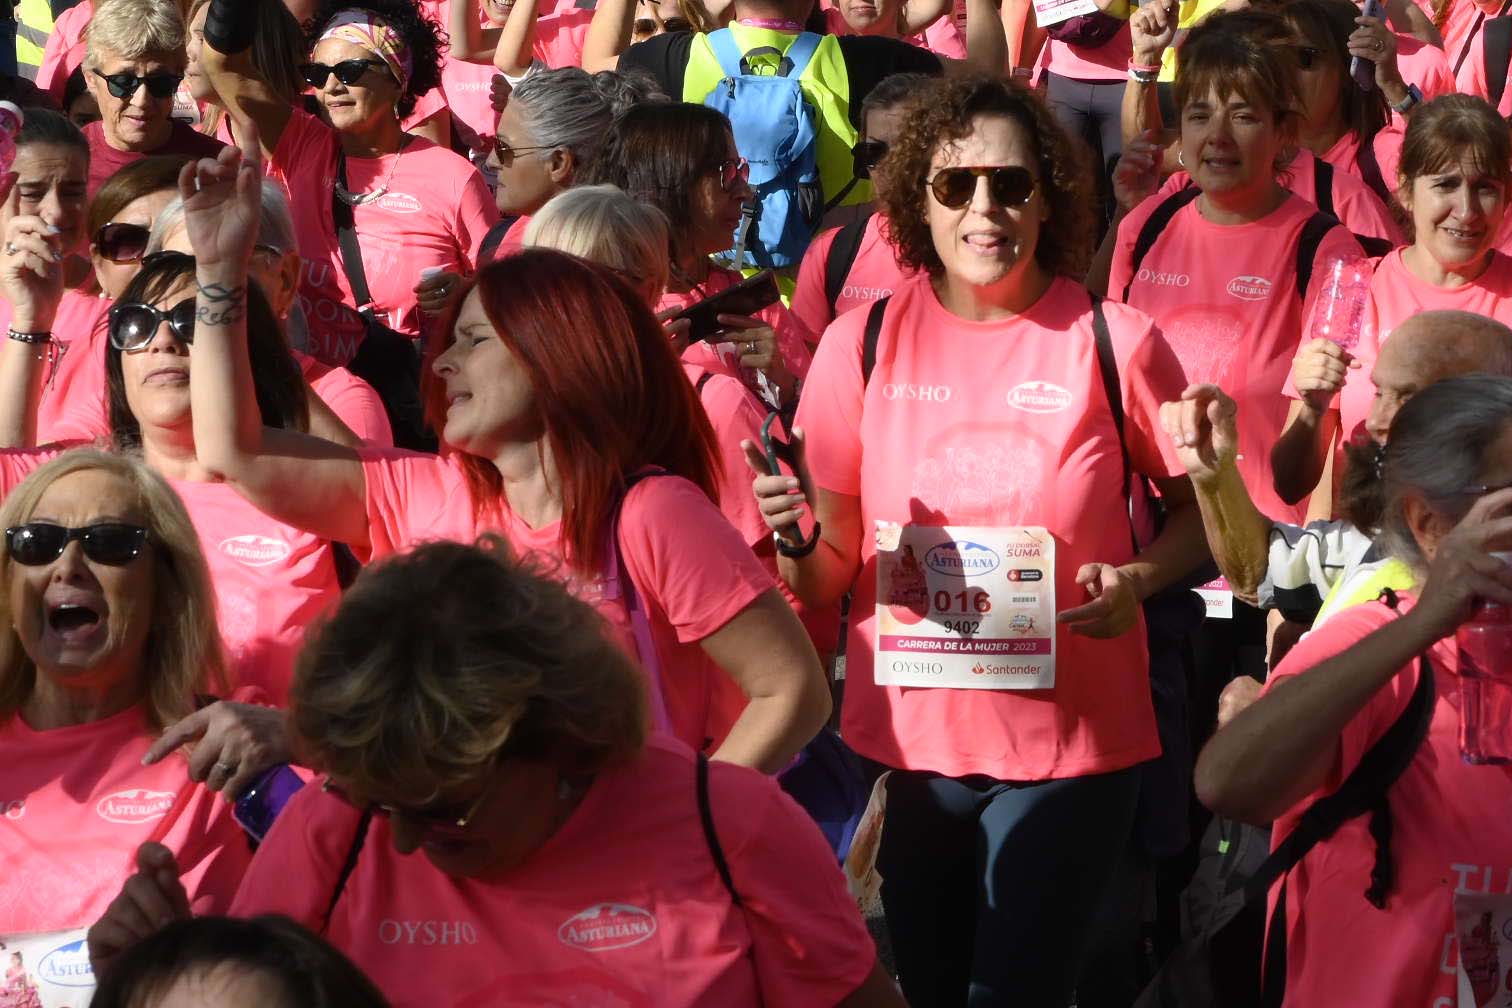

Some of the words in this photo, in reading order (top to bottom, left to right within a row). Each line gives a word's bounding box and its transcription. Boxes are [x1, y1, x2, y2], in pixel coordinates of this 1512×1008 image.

[1138, 268, 1190, 287] OYSHO
[882, 383, 952, 402] OYSHO
[931, 552, 994, 569] ASTURIANA
[1007, 548, 1041, 558] SUMA
[934, 590, 992, 613] 016
[944, 620, 980, 635] 9402
[897, 639, 942, 651] CARRERA
[944, 641, 958, 651] DE
[960, 642, 973, 651] LA
[975, 642, 1009, 652] MUJER
[1013, 643, 1037, 652] 2023
[892, 660, 943, 675] OYSHO
[986, 663, 1041, 675] Santander
[379, 919, 478, 946] OYSHO
[567, 920, 650, 944] ASTURIANA
[46, 961, 92, 977] ASTUR
